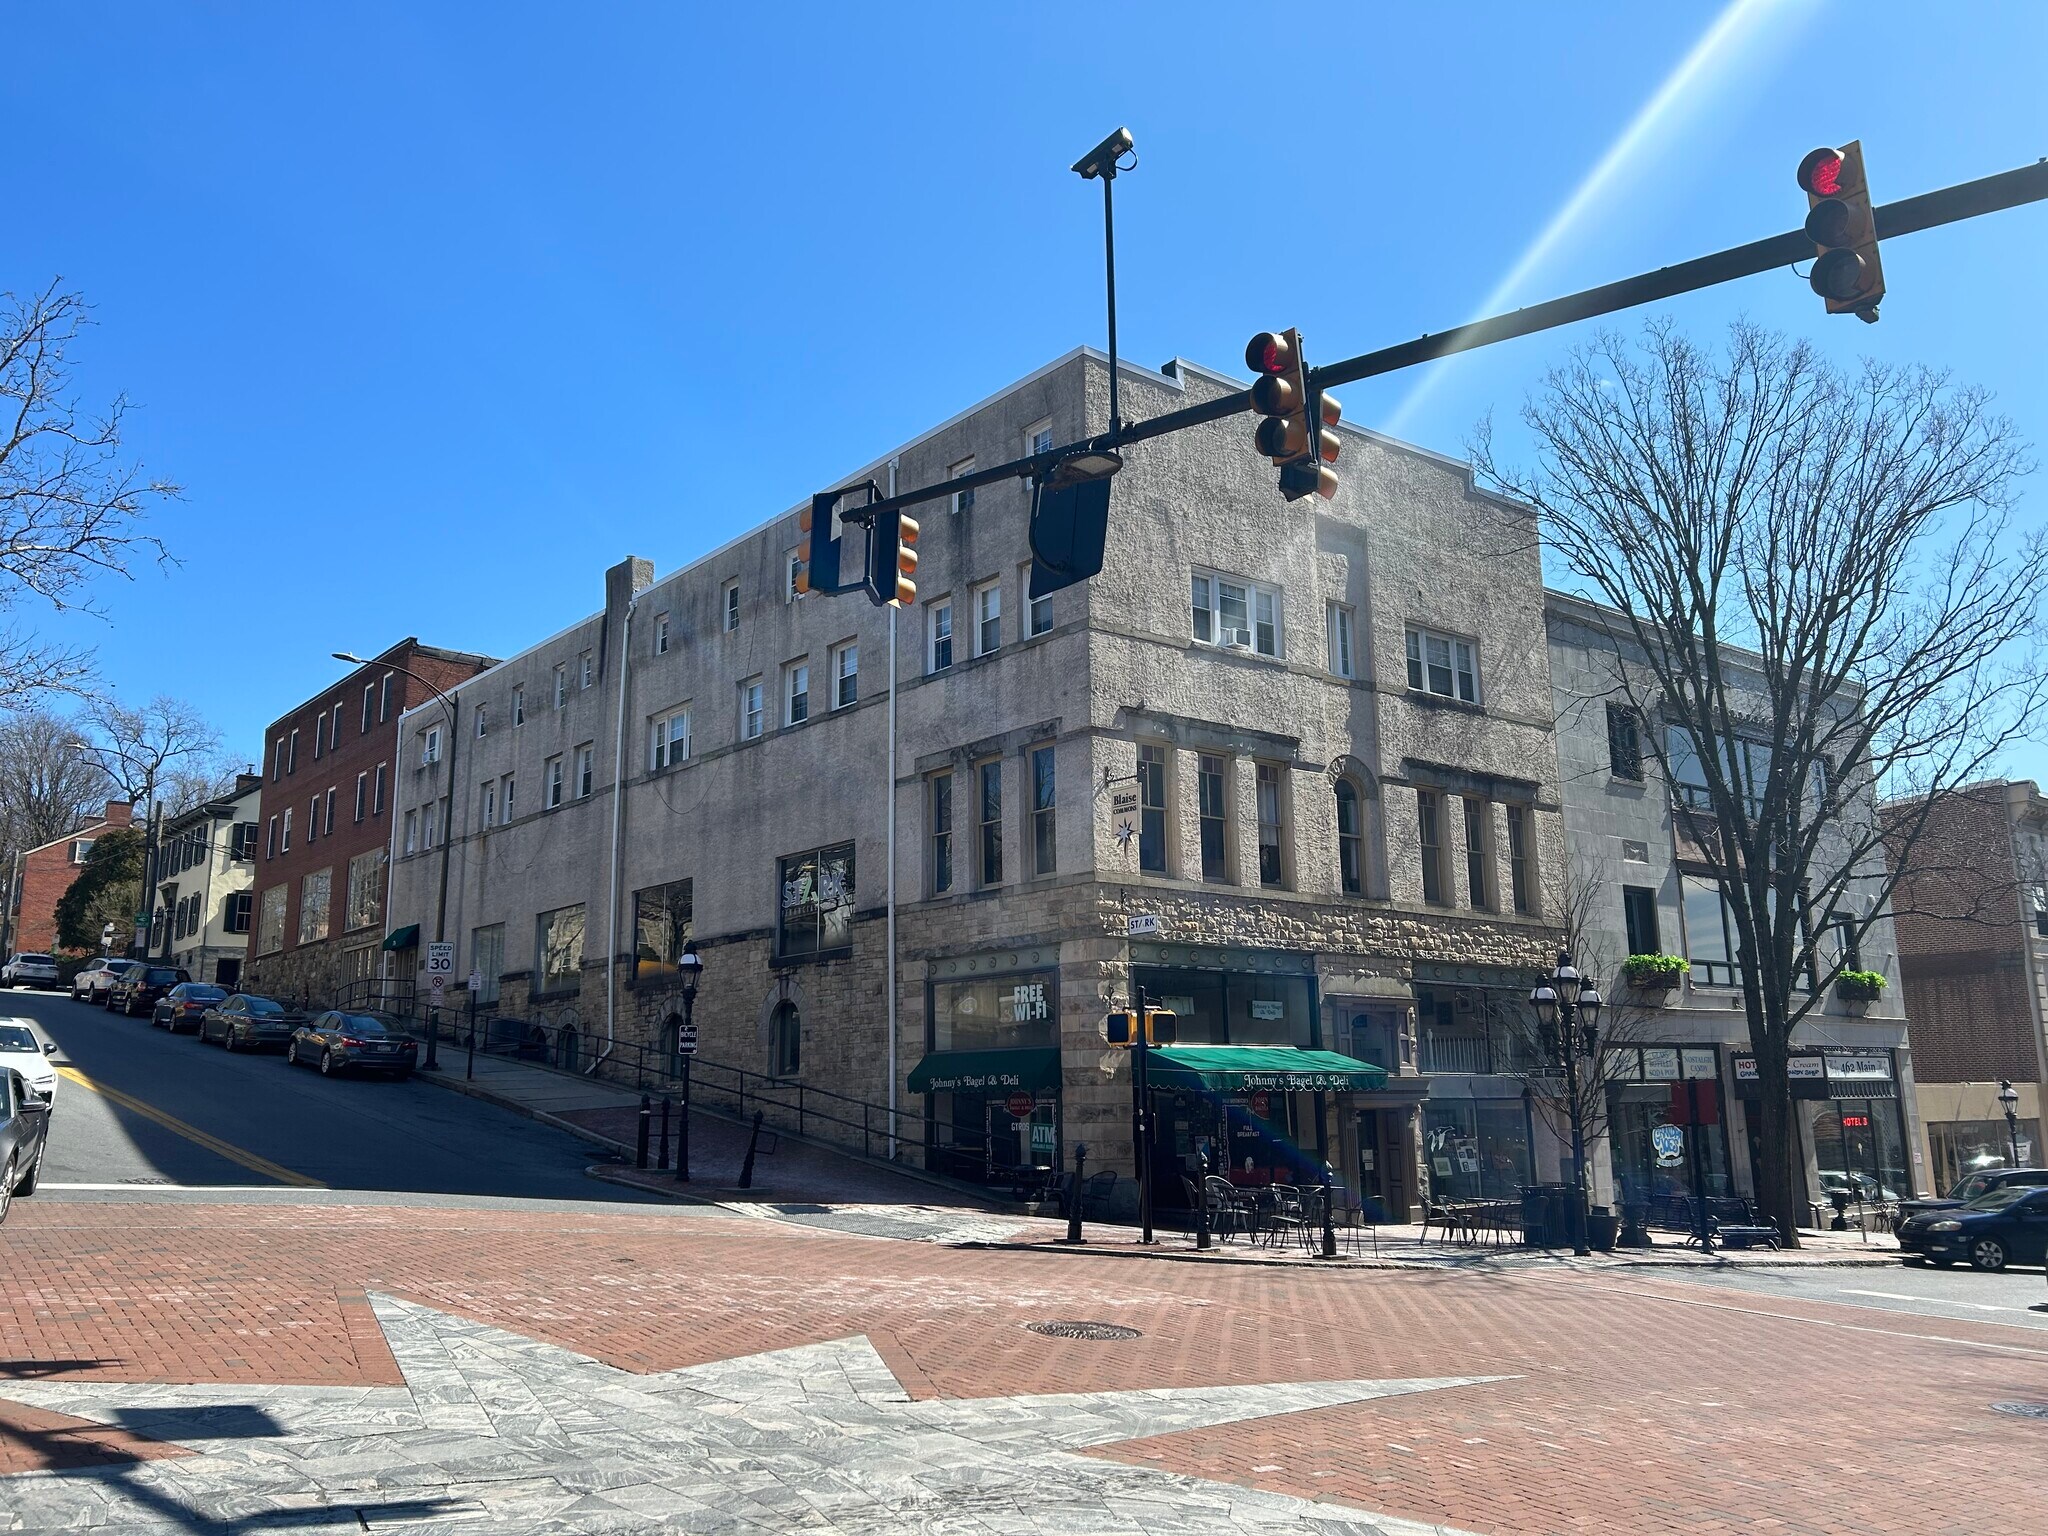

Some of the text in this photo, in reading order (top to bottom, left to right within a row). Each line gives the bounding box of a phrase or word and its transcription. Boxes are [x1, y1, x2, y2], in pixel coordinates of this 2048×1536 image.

[1113, 793, 1137, 805] Blaise
[1113, 805, 1137, 815] COMMONS
[430, 958, 450, 970] 30
[1013, 984, 1044, 1004] FREE
[1013, 1001, 1047, 1021] WI-FI
[1793, 1060, 1819, 1068] Cream
[1841, 1061, 1876, 1073] 462 Main
[930, 1074, 1019, 1090] Johnny's Bagel & Deli
[1244, 1074, 1349, 1087] Johnny's Bagel & Deli
[1011, 1122, 1030, 1131] GYROS
[1032, 1126, 1054, 1143] ATM
